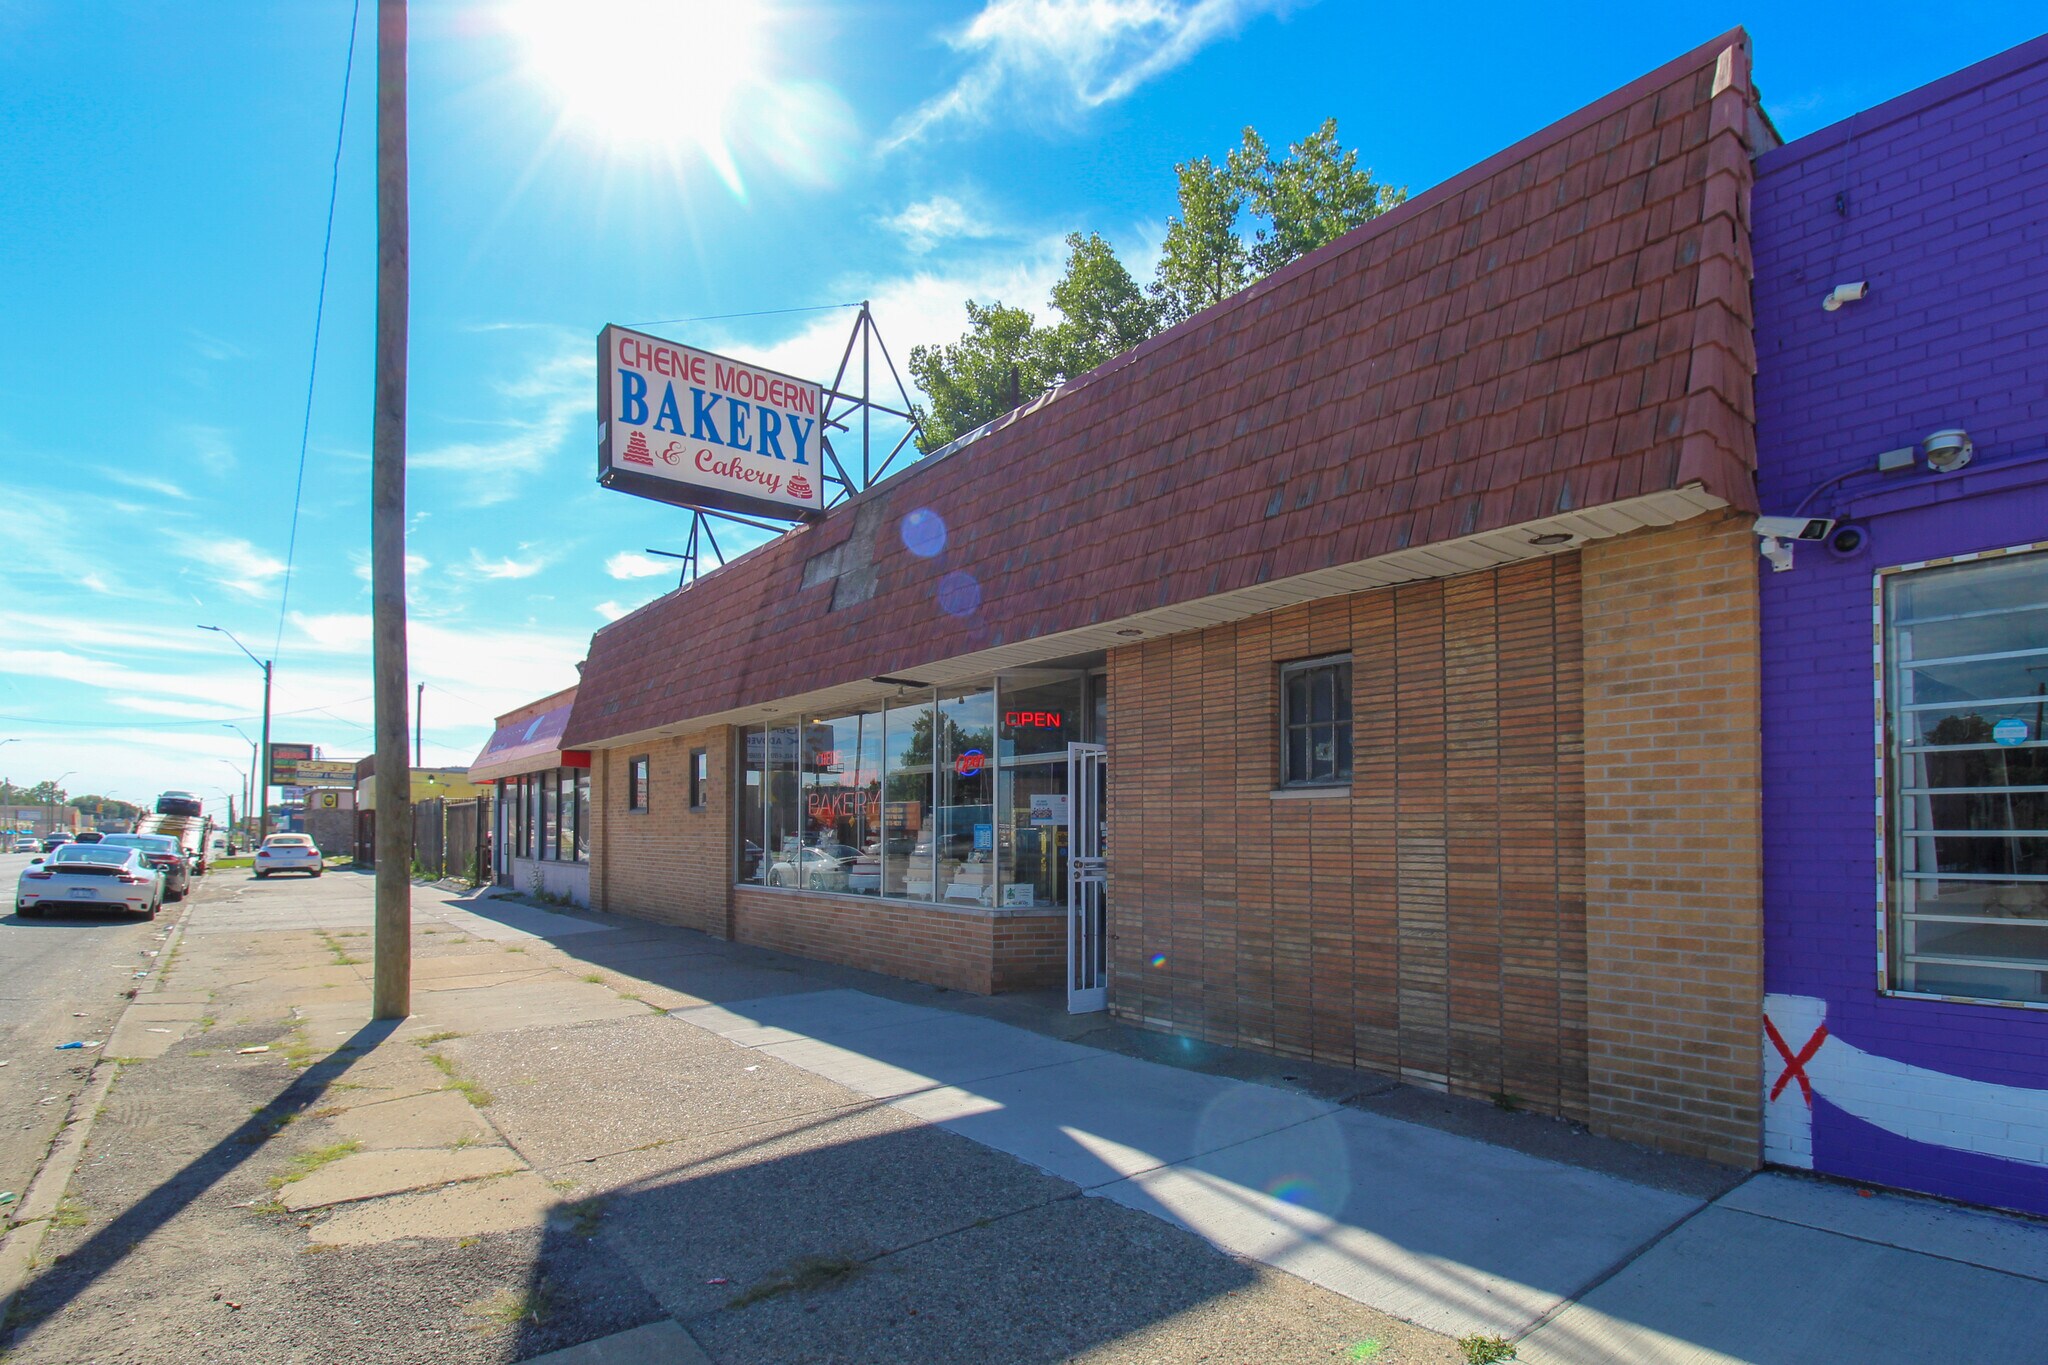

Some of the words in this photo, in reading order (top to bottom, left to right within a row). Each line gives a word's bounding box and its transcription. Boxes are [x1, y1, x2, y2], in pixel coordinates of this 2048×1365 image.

[619, 337, 706, 386] CHENE
[715, 362, 815, 415] MODERN
[617, 368, 815, 466] BAKERY
[655, 440, 687, 466] &
[694, 448, 783, 494] Cakery
[1005, 711, 1061, 728] OPEN
[955, 753, 985, 773] Open
[808, 789, 881, 817] BAKERY
